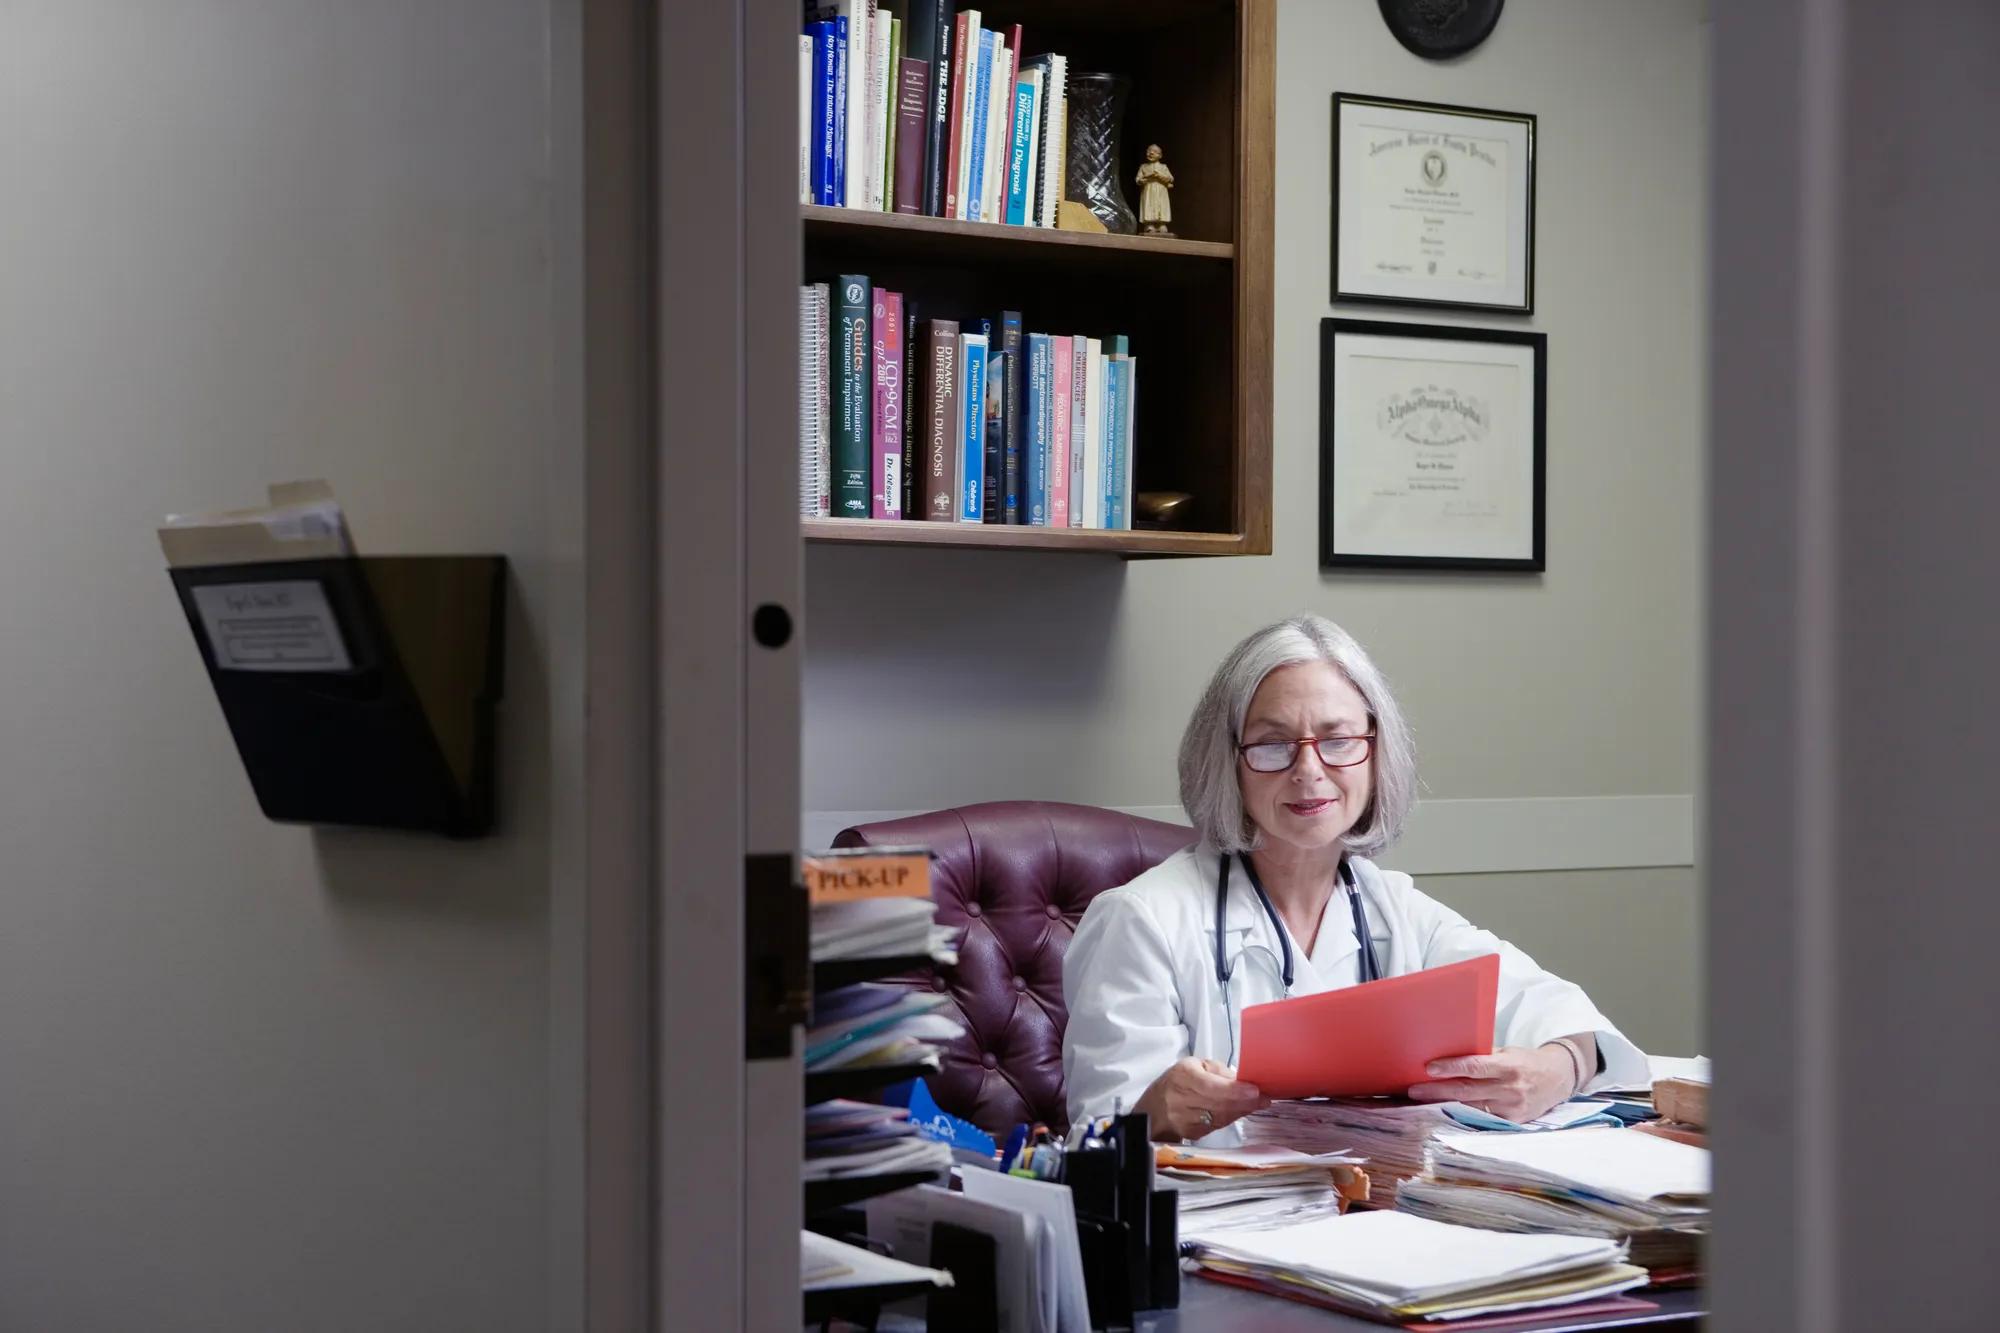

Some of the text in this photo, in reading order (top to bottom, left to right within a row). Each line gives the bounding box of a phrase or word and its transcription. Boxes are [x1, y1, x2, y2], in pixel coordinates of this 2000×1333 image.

[876, 67, 884, 104] DEPRESSED
[940, 60, 948, 85] THE
[826, 94, 834, 124] Intuitive
[938, 88, 947, 122] EDGE
[826, 126, 834, 159] Manager
[1012, 92, 1027, 195] Differential Diagnosis
[854, 318, 867, 372] Guides
[874, 340, 886, 360] cpt
[1038, 344, 1046, 375] practical
[842, 316, 853, 431] of Permanent Impairment
[877, 364, 886, 386] 2001
[944, 346, 953, 398] DYNAMIC
[854, 395, 863, 442] Evaluation
[906, 377, 914, 432] Dermatologic
[933, 346, 945, 477] DIFFERENTIAL DIAGNOSIS
[970, 359, 980, 441] Physicians Directory
[1037, 377, 1046, 445] electrocardiography
[1056, 393, 1065, 431] PEDIATRIC
[1108, 391, 1116, 439] CARDIOVASCULAR
[1388, 395, 1481, 426] Alpha Omega Alpha
[905, 435, 913, 467] Therapy
[1055, 433, 1064, 487] EMERGENCIES
[886, 479, 894, 507] Olsson
[818, 865, 910, 891] PICK-UP
